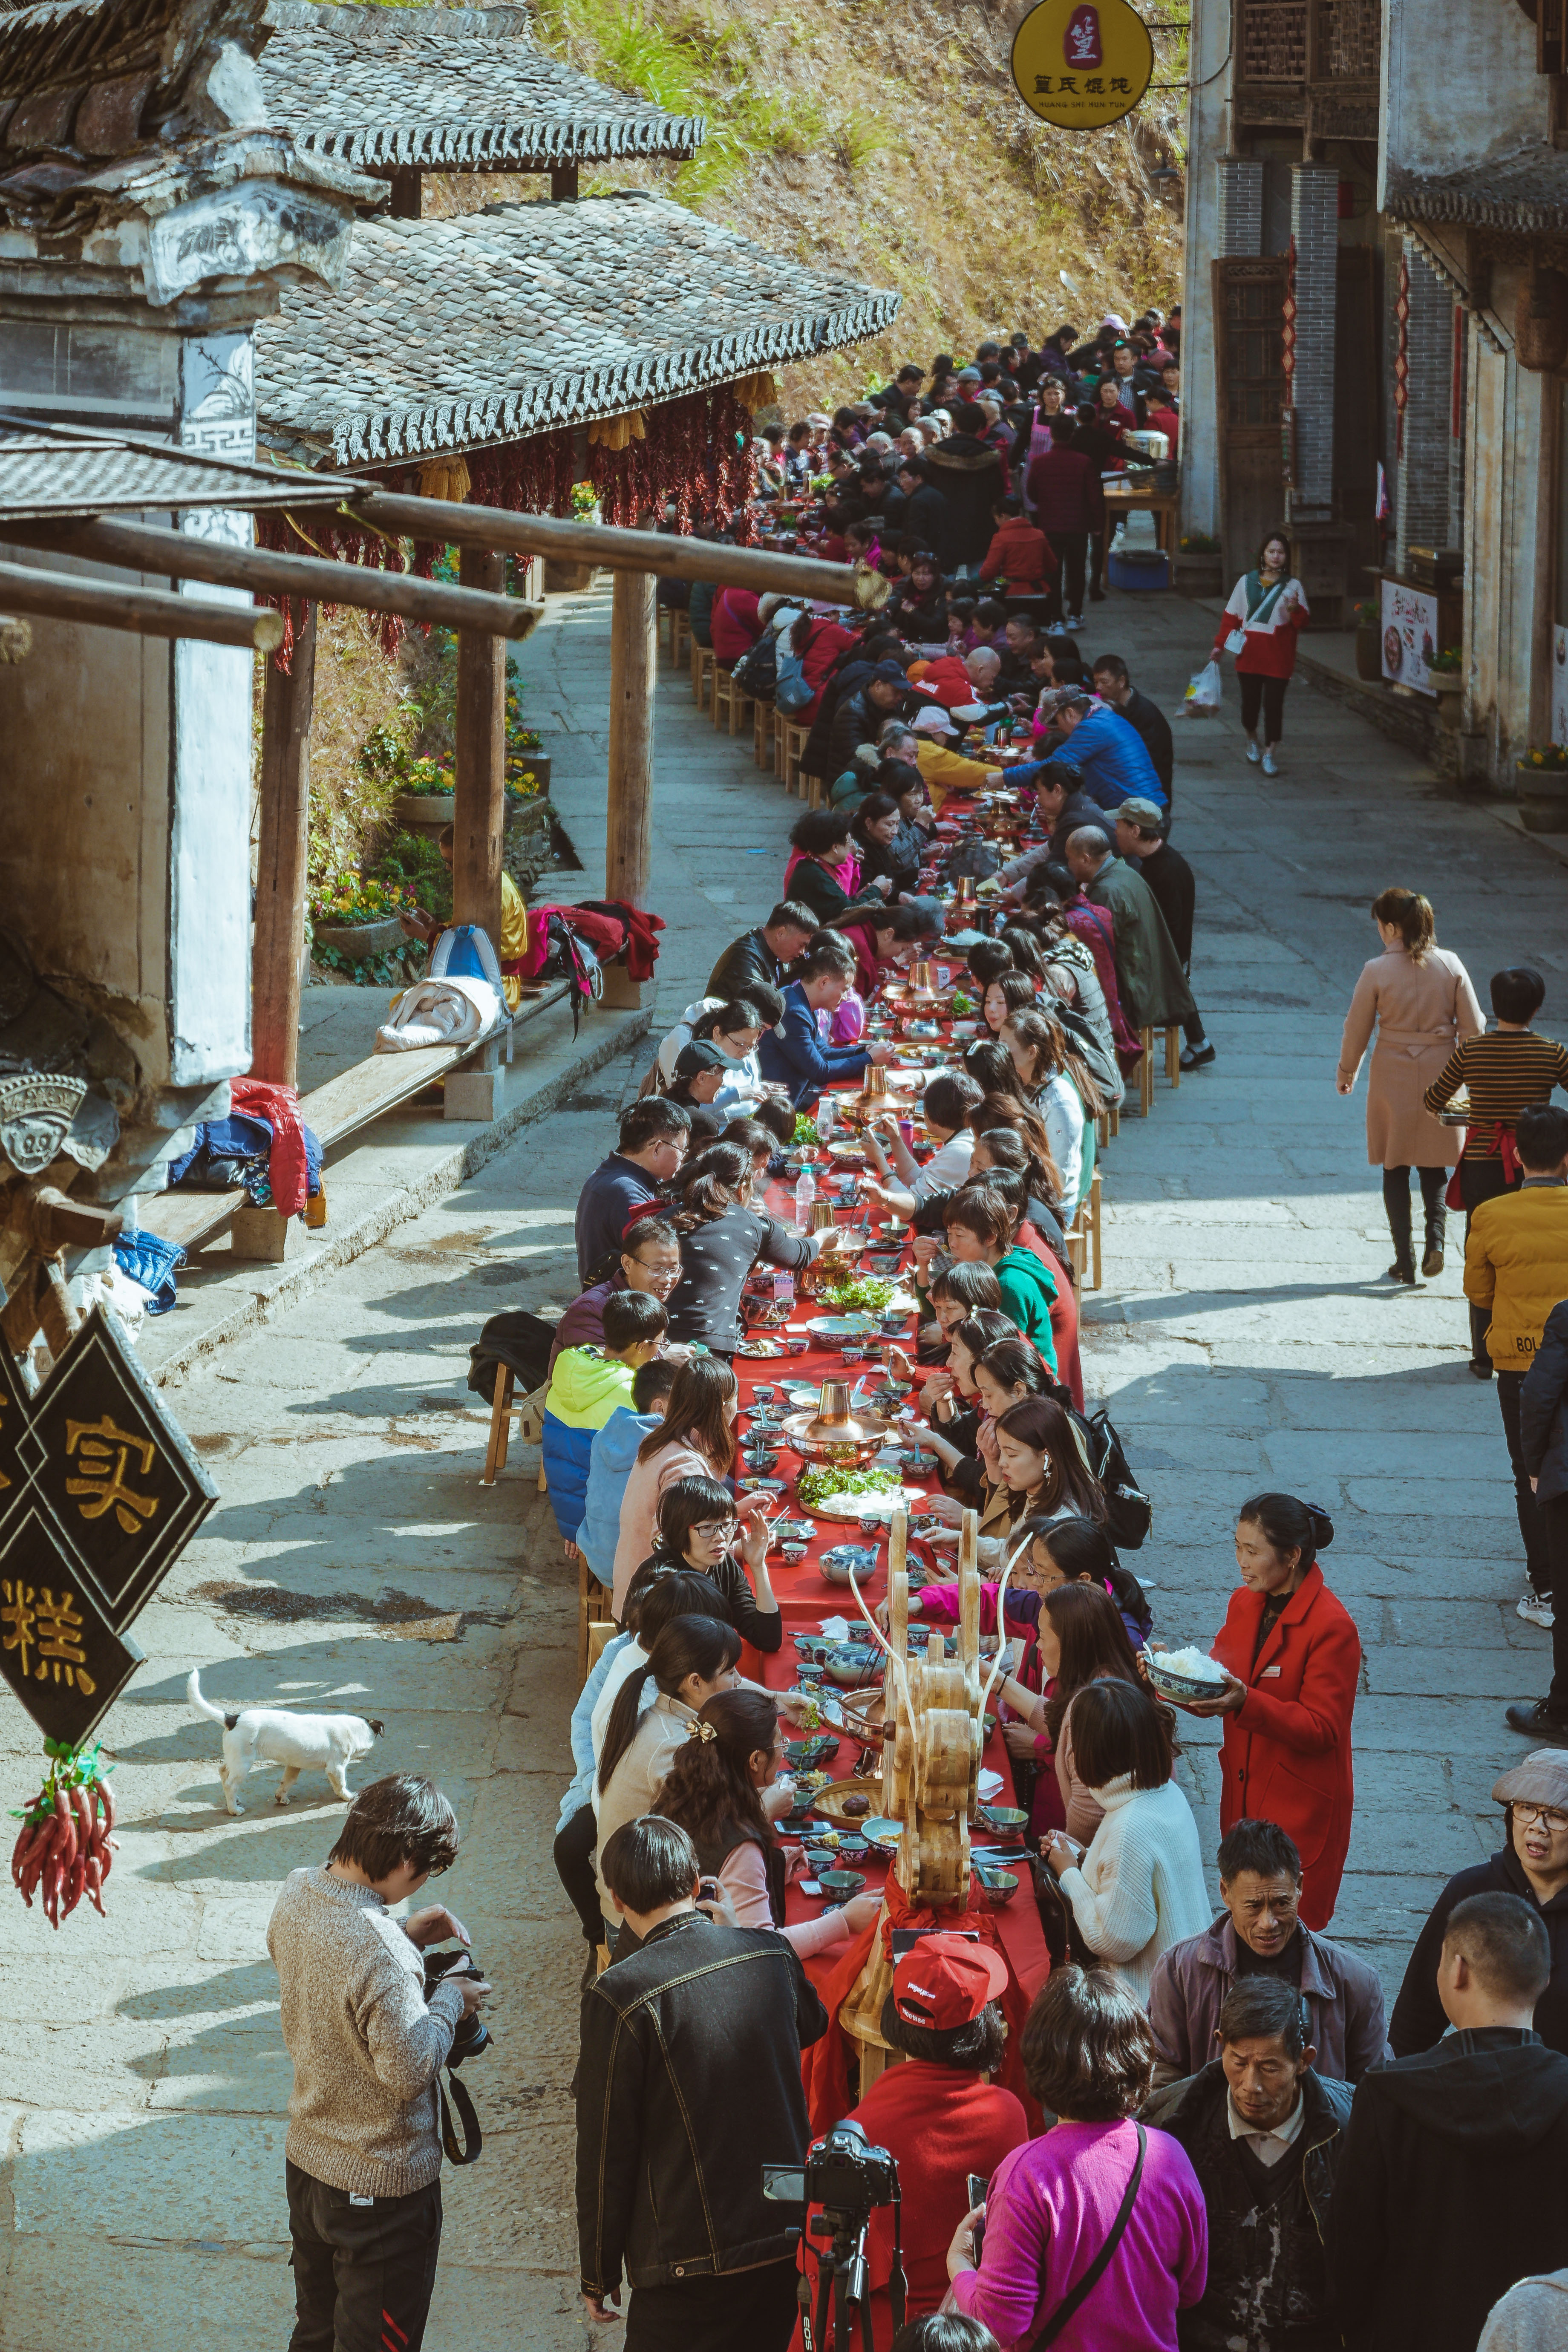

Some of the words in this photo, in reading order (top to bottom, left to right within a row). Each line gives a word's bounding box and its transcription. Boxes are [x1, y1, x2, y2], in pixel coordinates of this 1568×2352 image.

[1033, 74, 1132, 95] 篁氏馄饨
[1, 1579, 97, 1696] 糕
[804, 2316, 812, 2351] EOS
